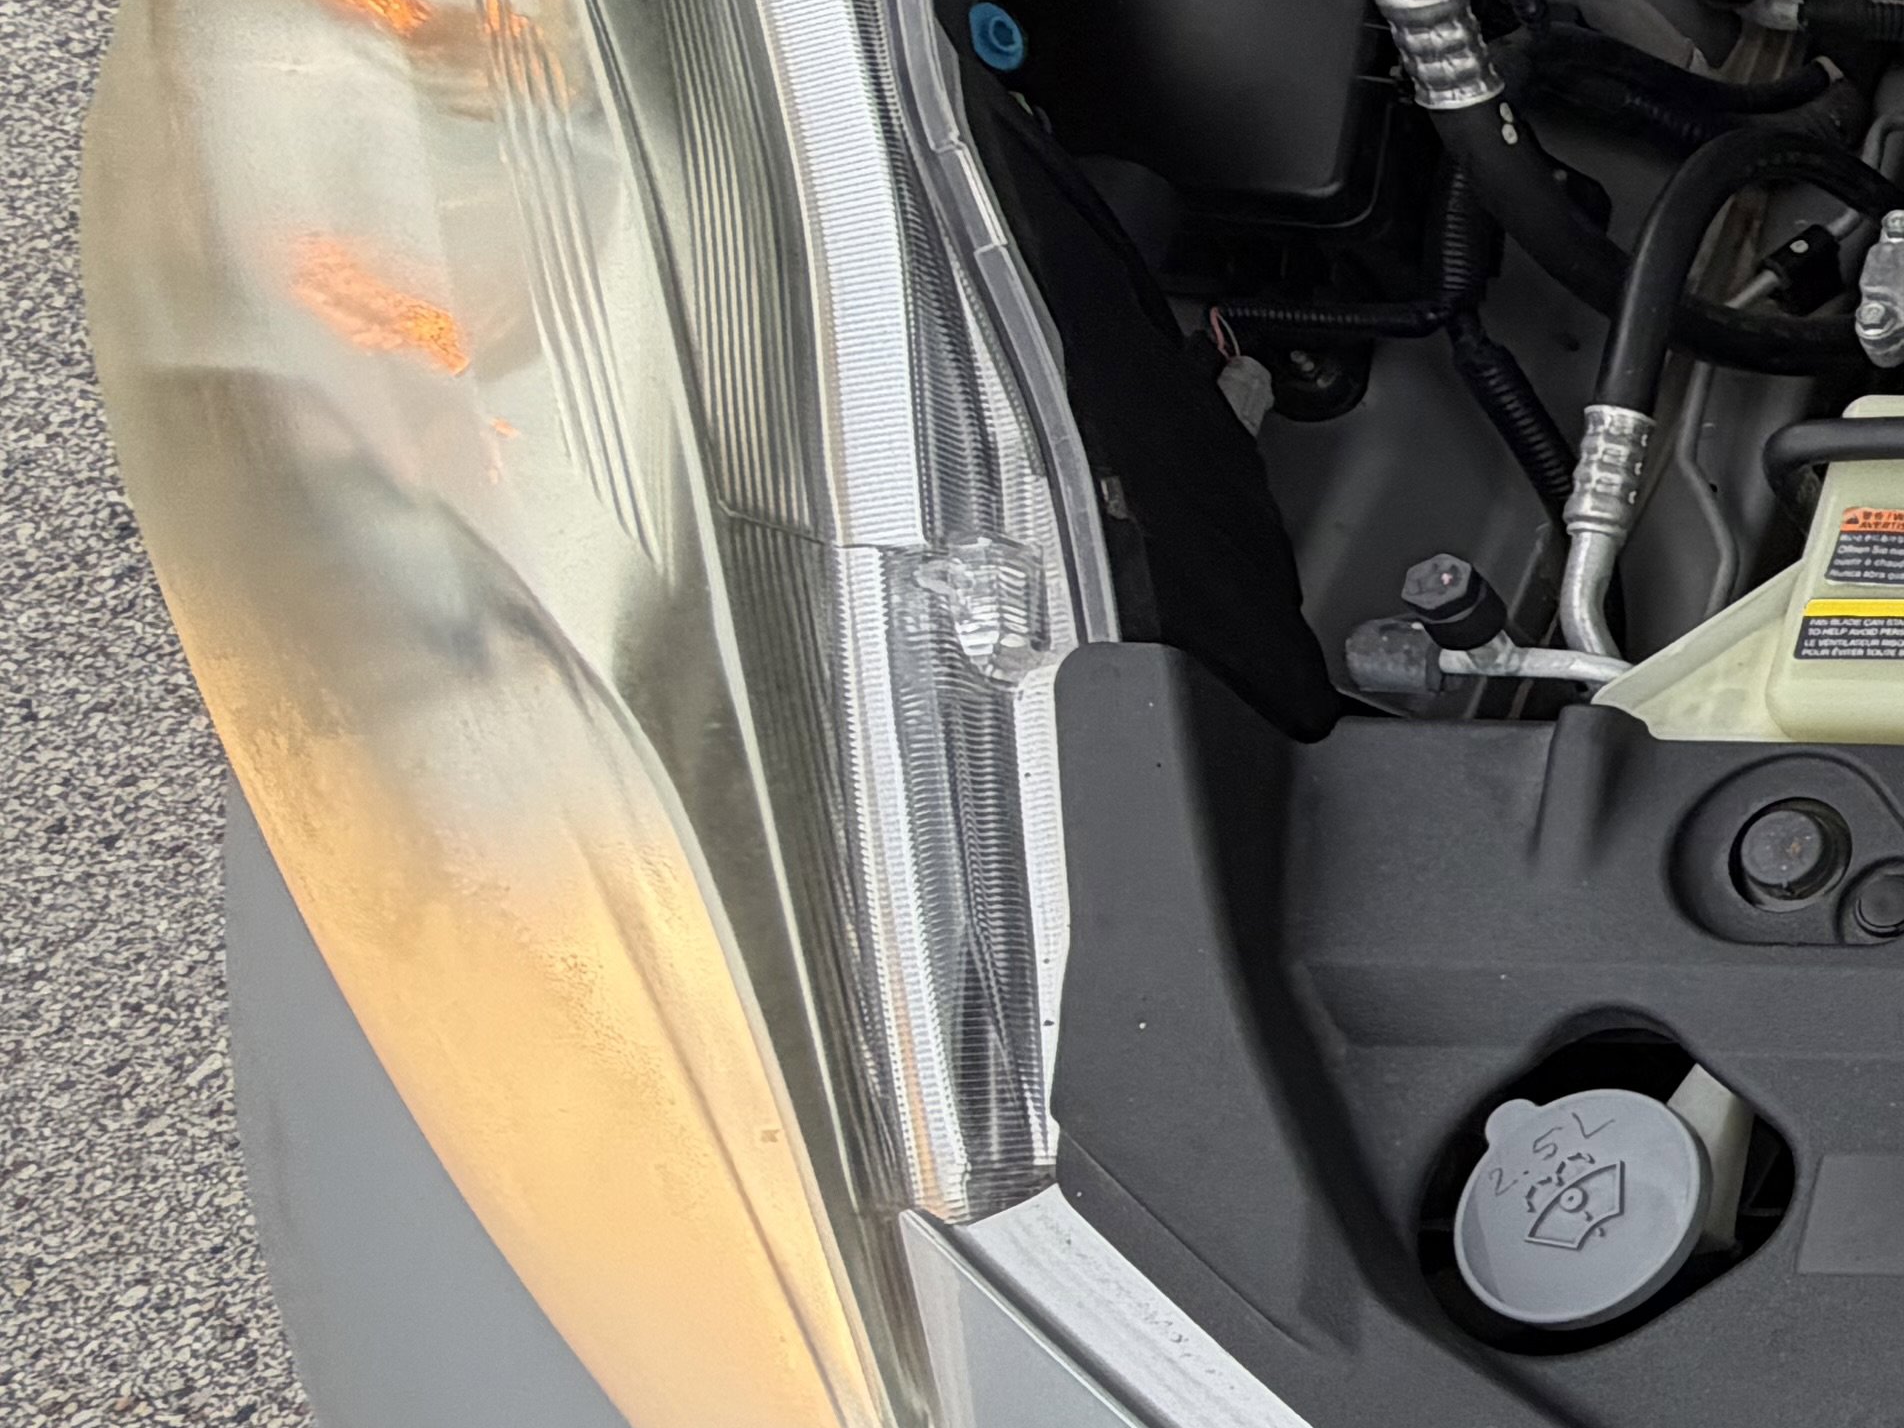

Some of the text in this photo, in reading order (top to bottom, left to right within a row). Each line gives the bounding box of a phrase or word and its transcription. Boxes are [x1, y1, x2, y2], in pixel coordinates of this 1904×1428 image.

[1863, 618, 1885, 626] CAN
[1808, 627, 1821, 636] TO
[1822, 627, 1848, 636] HELP
[1848, 628, 1878, 636] AVOID
[1804, 639, 1816, 647] LE
[1818, 638, 1880, 647] VENTILATEUR
[1801, 648, 1830, 656] POUR
[1866, 648, 1896, 657] TOUTE
